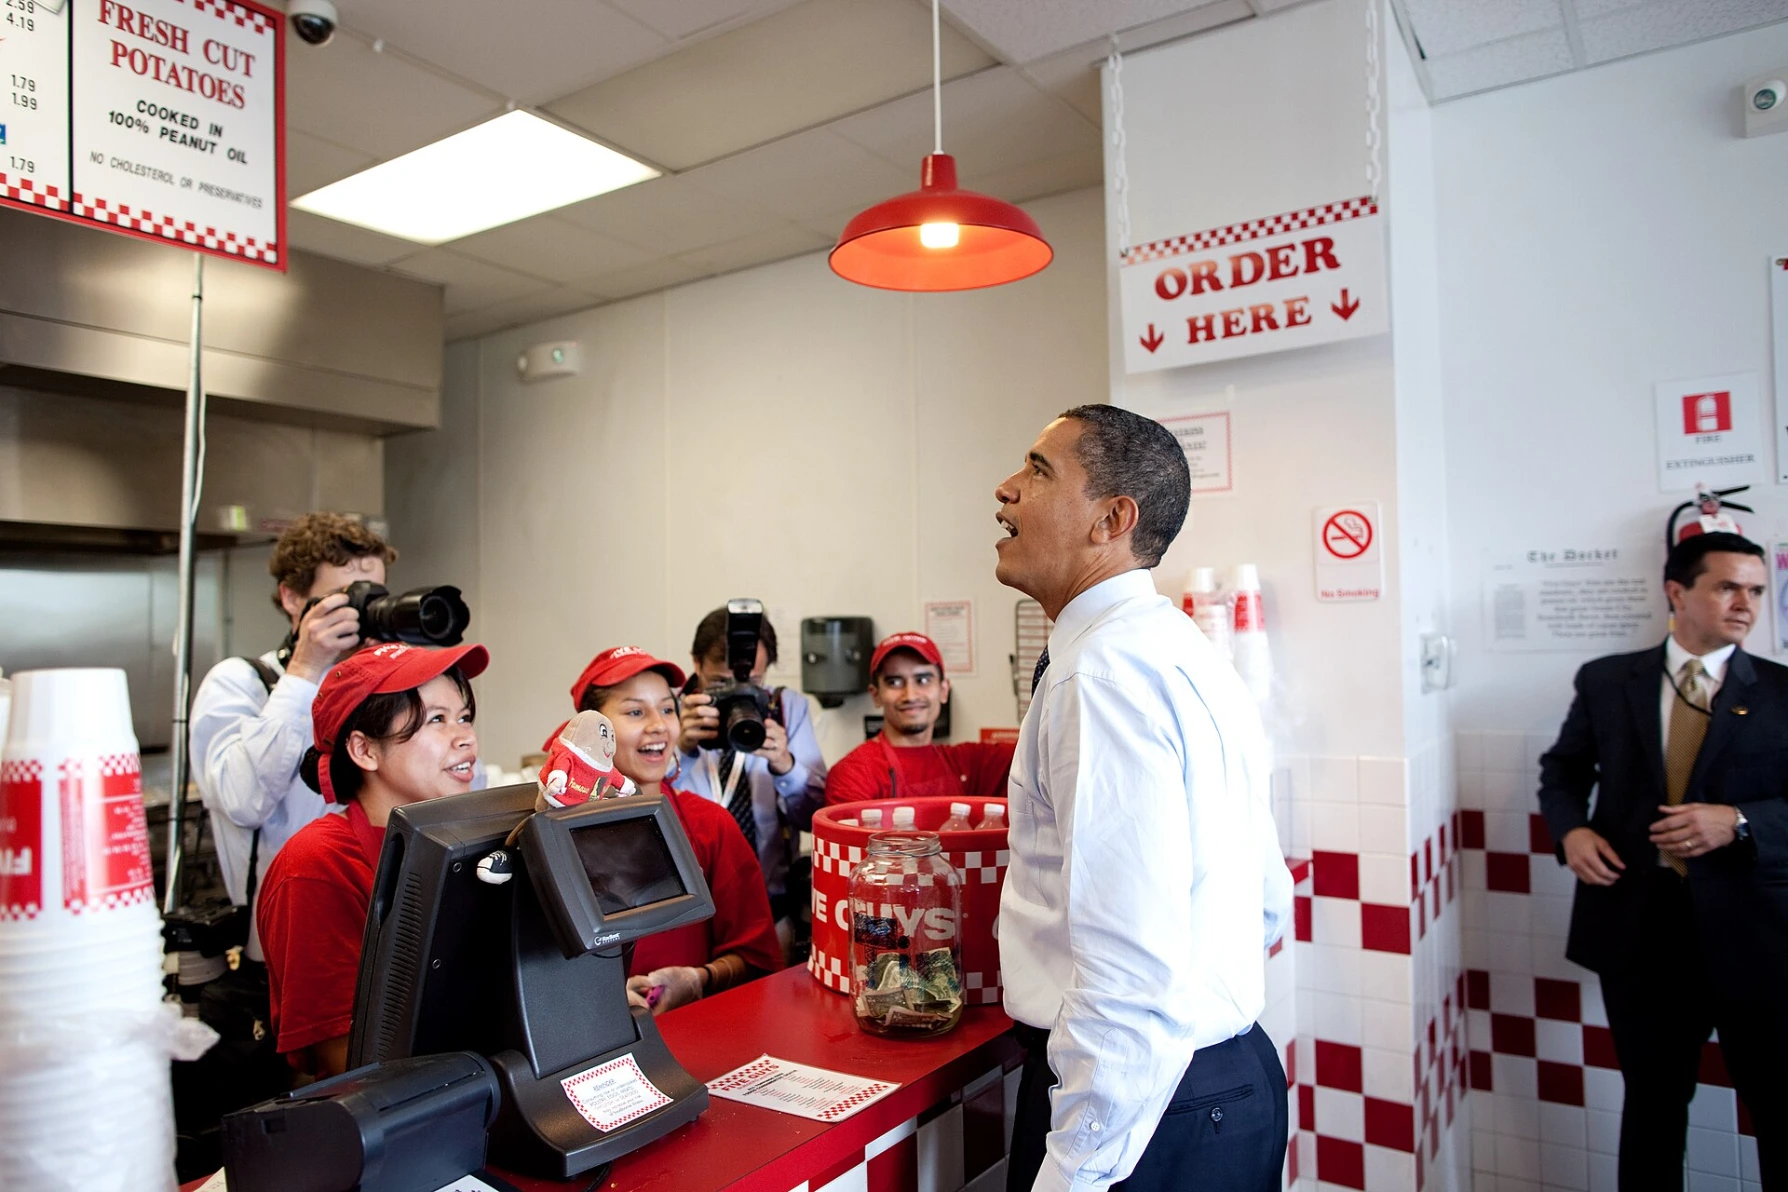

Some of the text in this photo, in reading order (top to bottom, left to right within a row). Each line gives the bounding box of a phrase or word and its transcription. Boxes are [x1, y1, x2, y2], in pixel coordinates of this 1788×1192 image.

[6, 12, 35, 31] 4.19
[98, 0, 255, 78] FRESH CUT
[11, 74, 36, 92] 1.79
[110, 39, 246, 110] POTATOES
[12, 93, 37, 110] 1.99
[136, 99, 223, 138] COOKED IN
[108, 111, 248, 165] 100% PEANUT OIL
[10, 156, 36, 173] 1.79
[90, 151, 263, 209] NO CHOLESTEROL OR PRESERVATIVES
[1154, 236, 1341, 301] ORDER
[1186, 296, 1313, 345] HERE
[1695, 433, 1723, 445] FIRE
[1666, 453, 1756, 471] EXTINGUISHER
[1321, 587, 1380, 600] No Smoking
[721, 1077, 749, 1092] FIVE
[750, 1063, 780, 1080] GUYS
